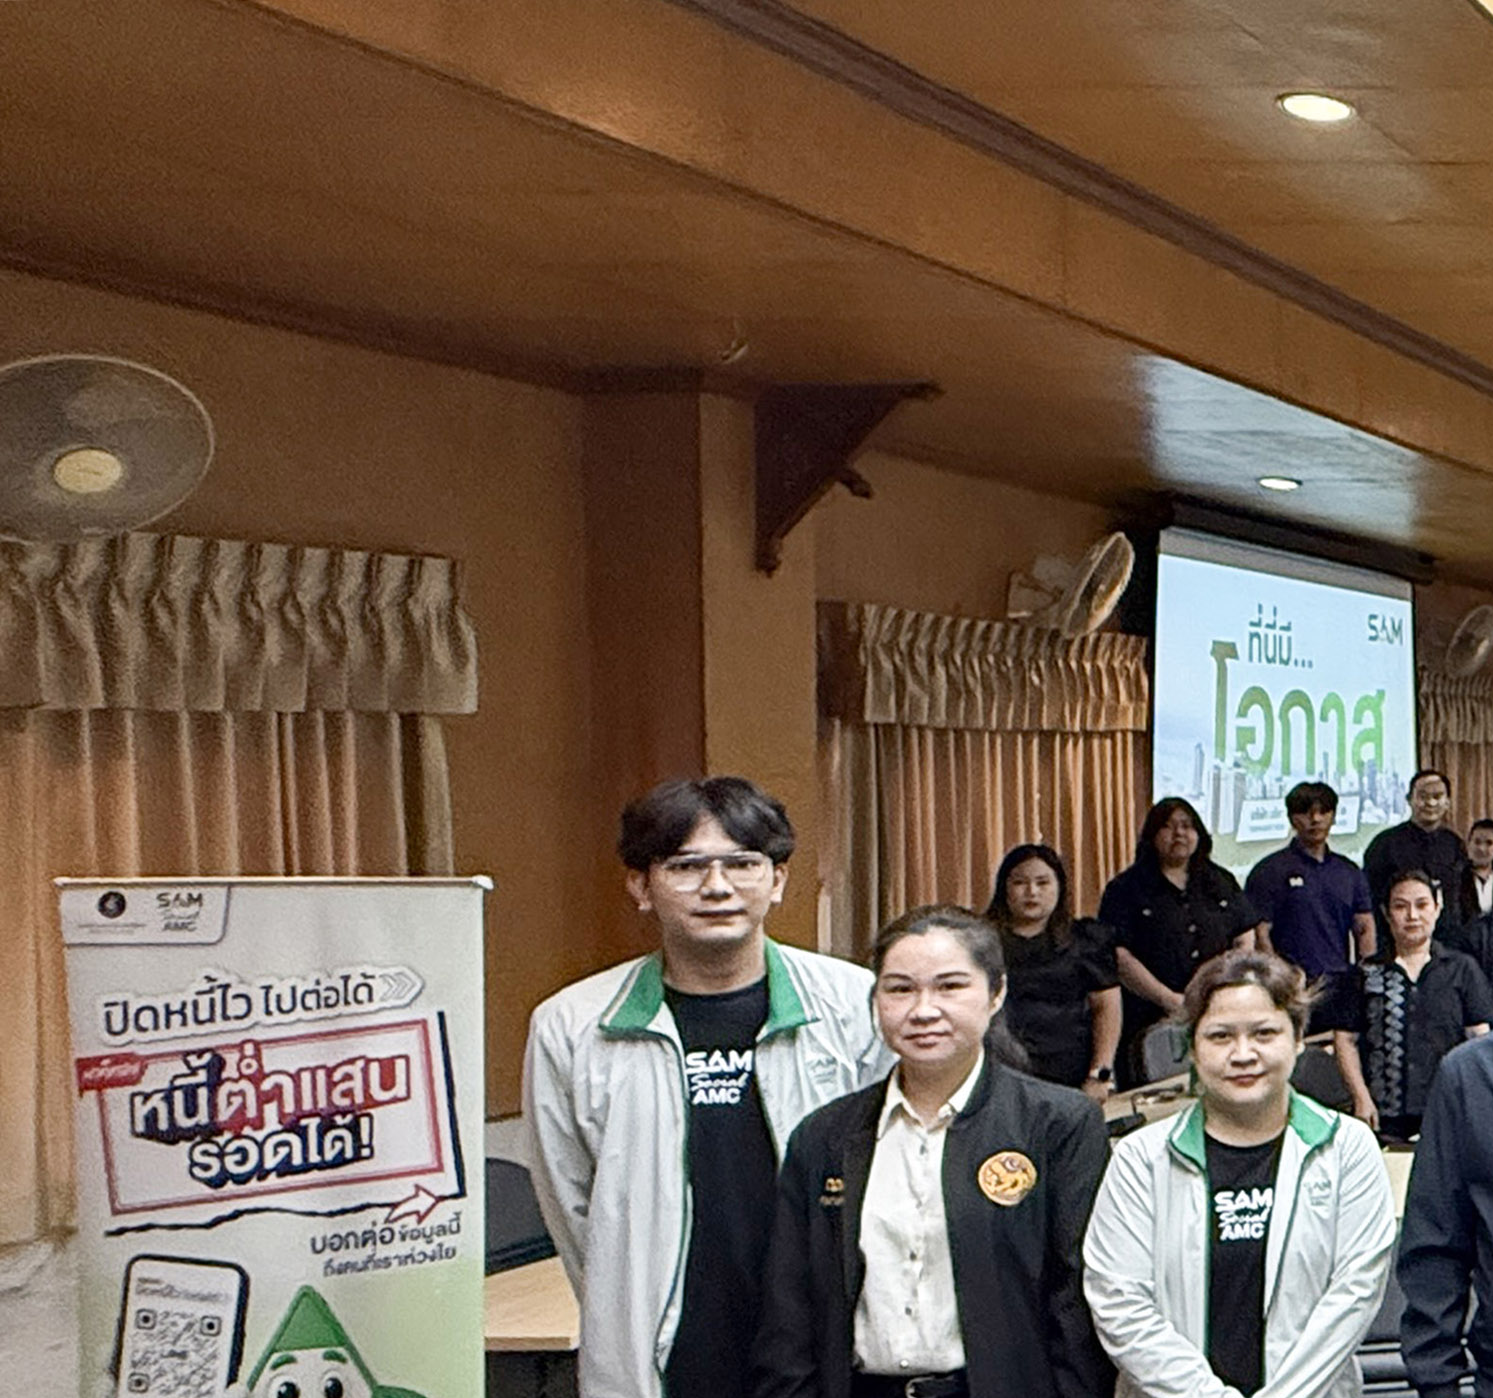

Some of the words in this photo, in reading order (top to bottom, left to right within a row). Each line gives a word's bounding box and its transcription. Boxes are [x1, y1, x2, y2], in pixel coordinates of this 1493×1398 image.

[1368, 614, 1404, 646] SAM
[1210, 639, 1386, 778] โอกาส
[104, 976, 253, 1036] ปิดหนี้ไว
[261, 973, 376, 1017] ไปต่อได้
[686, 1050, 753, 1074] SAM
[131, 1042, 410, 1135] หนี้ต่ำแสน
[692, 1087, 741, 1106] AMC
[190, 1114, 374, 1181] รอดได้!
[1214, 1187, 1274, 1213] SAM
[311, 1220, 395, 1255] บอกต่อ
[1220, 1222, 1265, 1241] AMC
